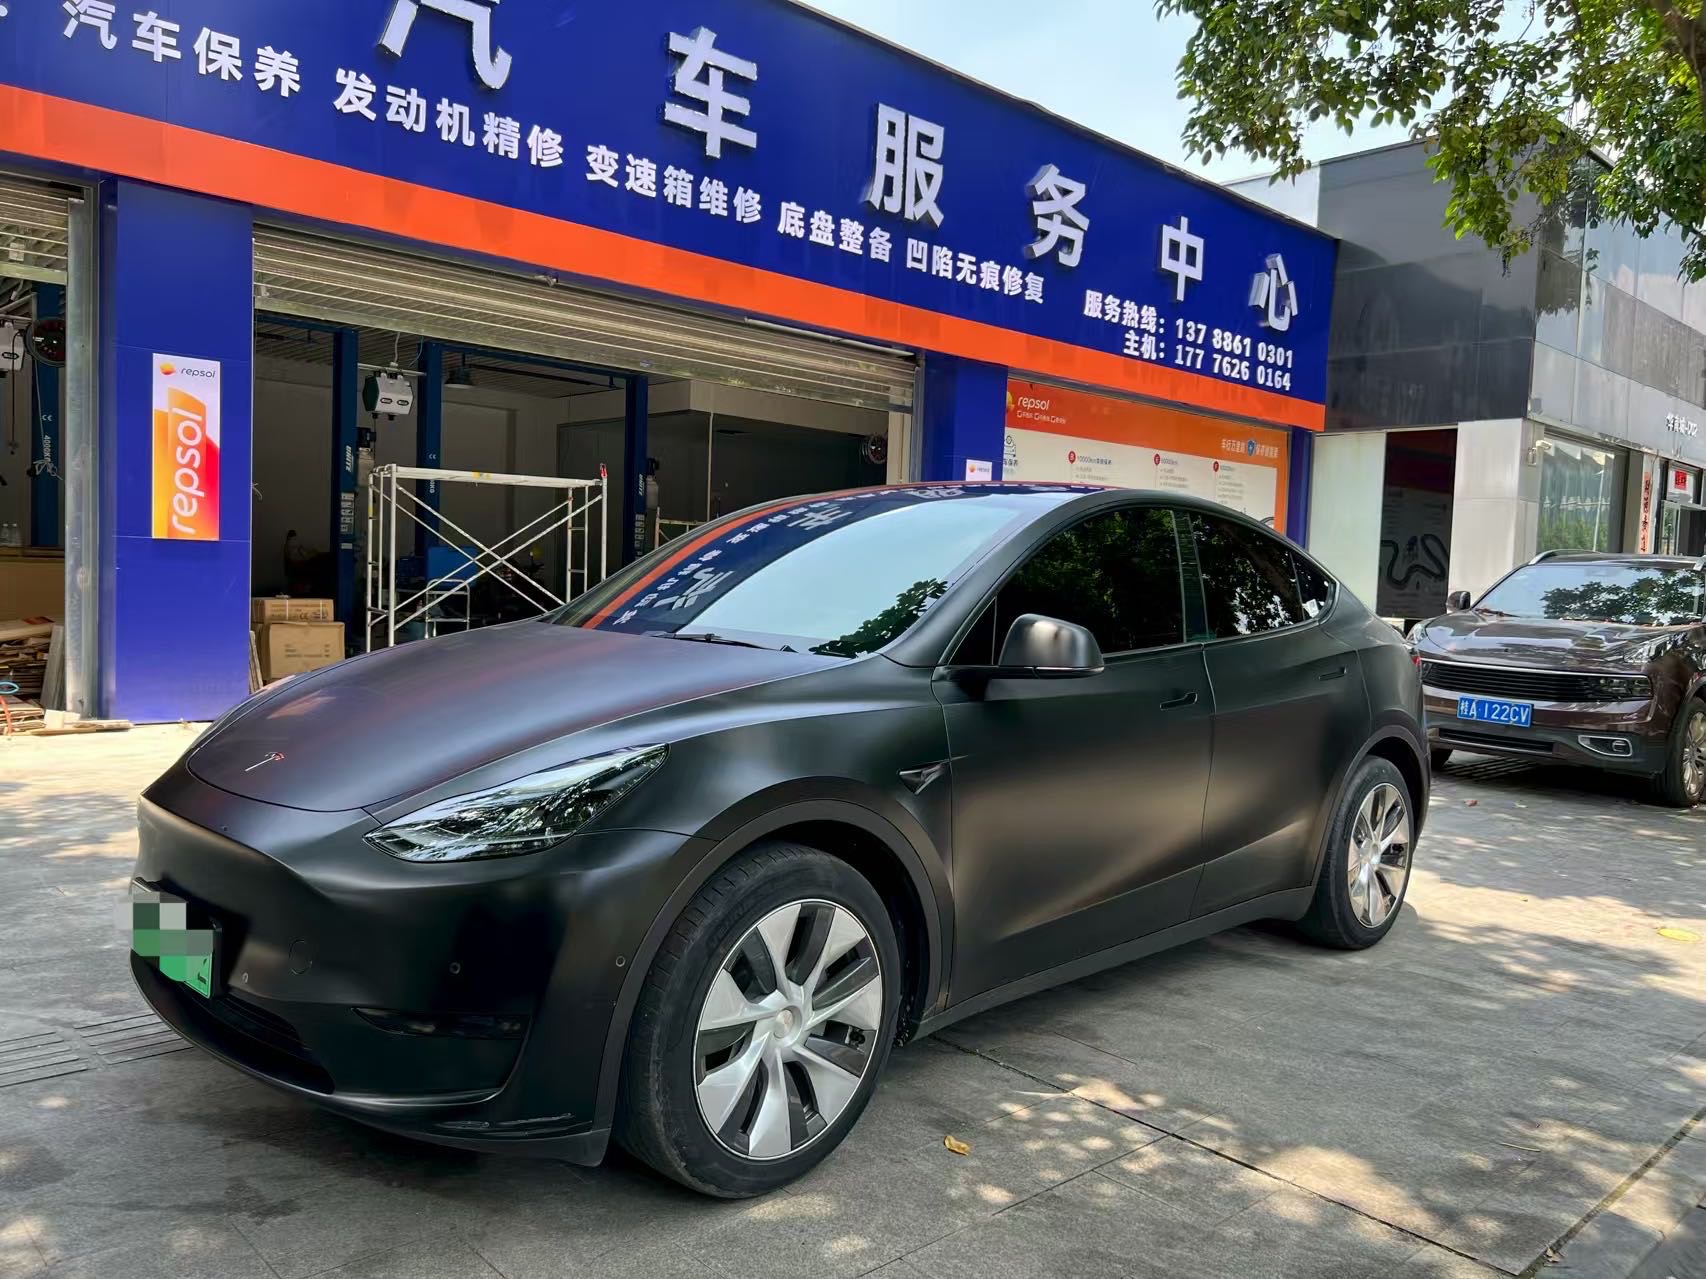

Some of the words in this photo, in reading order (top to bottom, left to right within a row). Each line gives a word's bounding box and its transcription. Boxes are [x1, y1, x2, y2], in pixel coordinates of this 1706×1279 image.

[63, 0, 300, 97] 汽车保养
[334, 68, 563, 168] 发动机精修
[585, 144, 762, 223] 变速箱维修
[777, 201, 893, 263] 底盘整备
[907, 238, 1044, 303] 凹陷无痕修复
[1176, 318, 1207, 344] 137
[1212, 328, 1251, 357] 8861
[1258, 342, 1293, 368] 0301
[180, 367, 216, 379] repsol
[1175, 344, 1205, 369] 177
[1213, 353, 1250, 381] 7626
[1256, 365, 1291, 391] 0164
[1017, 396, 1050, 410] repsol
[171, 407, 203, 535] repsol
